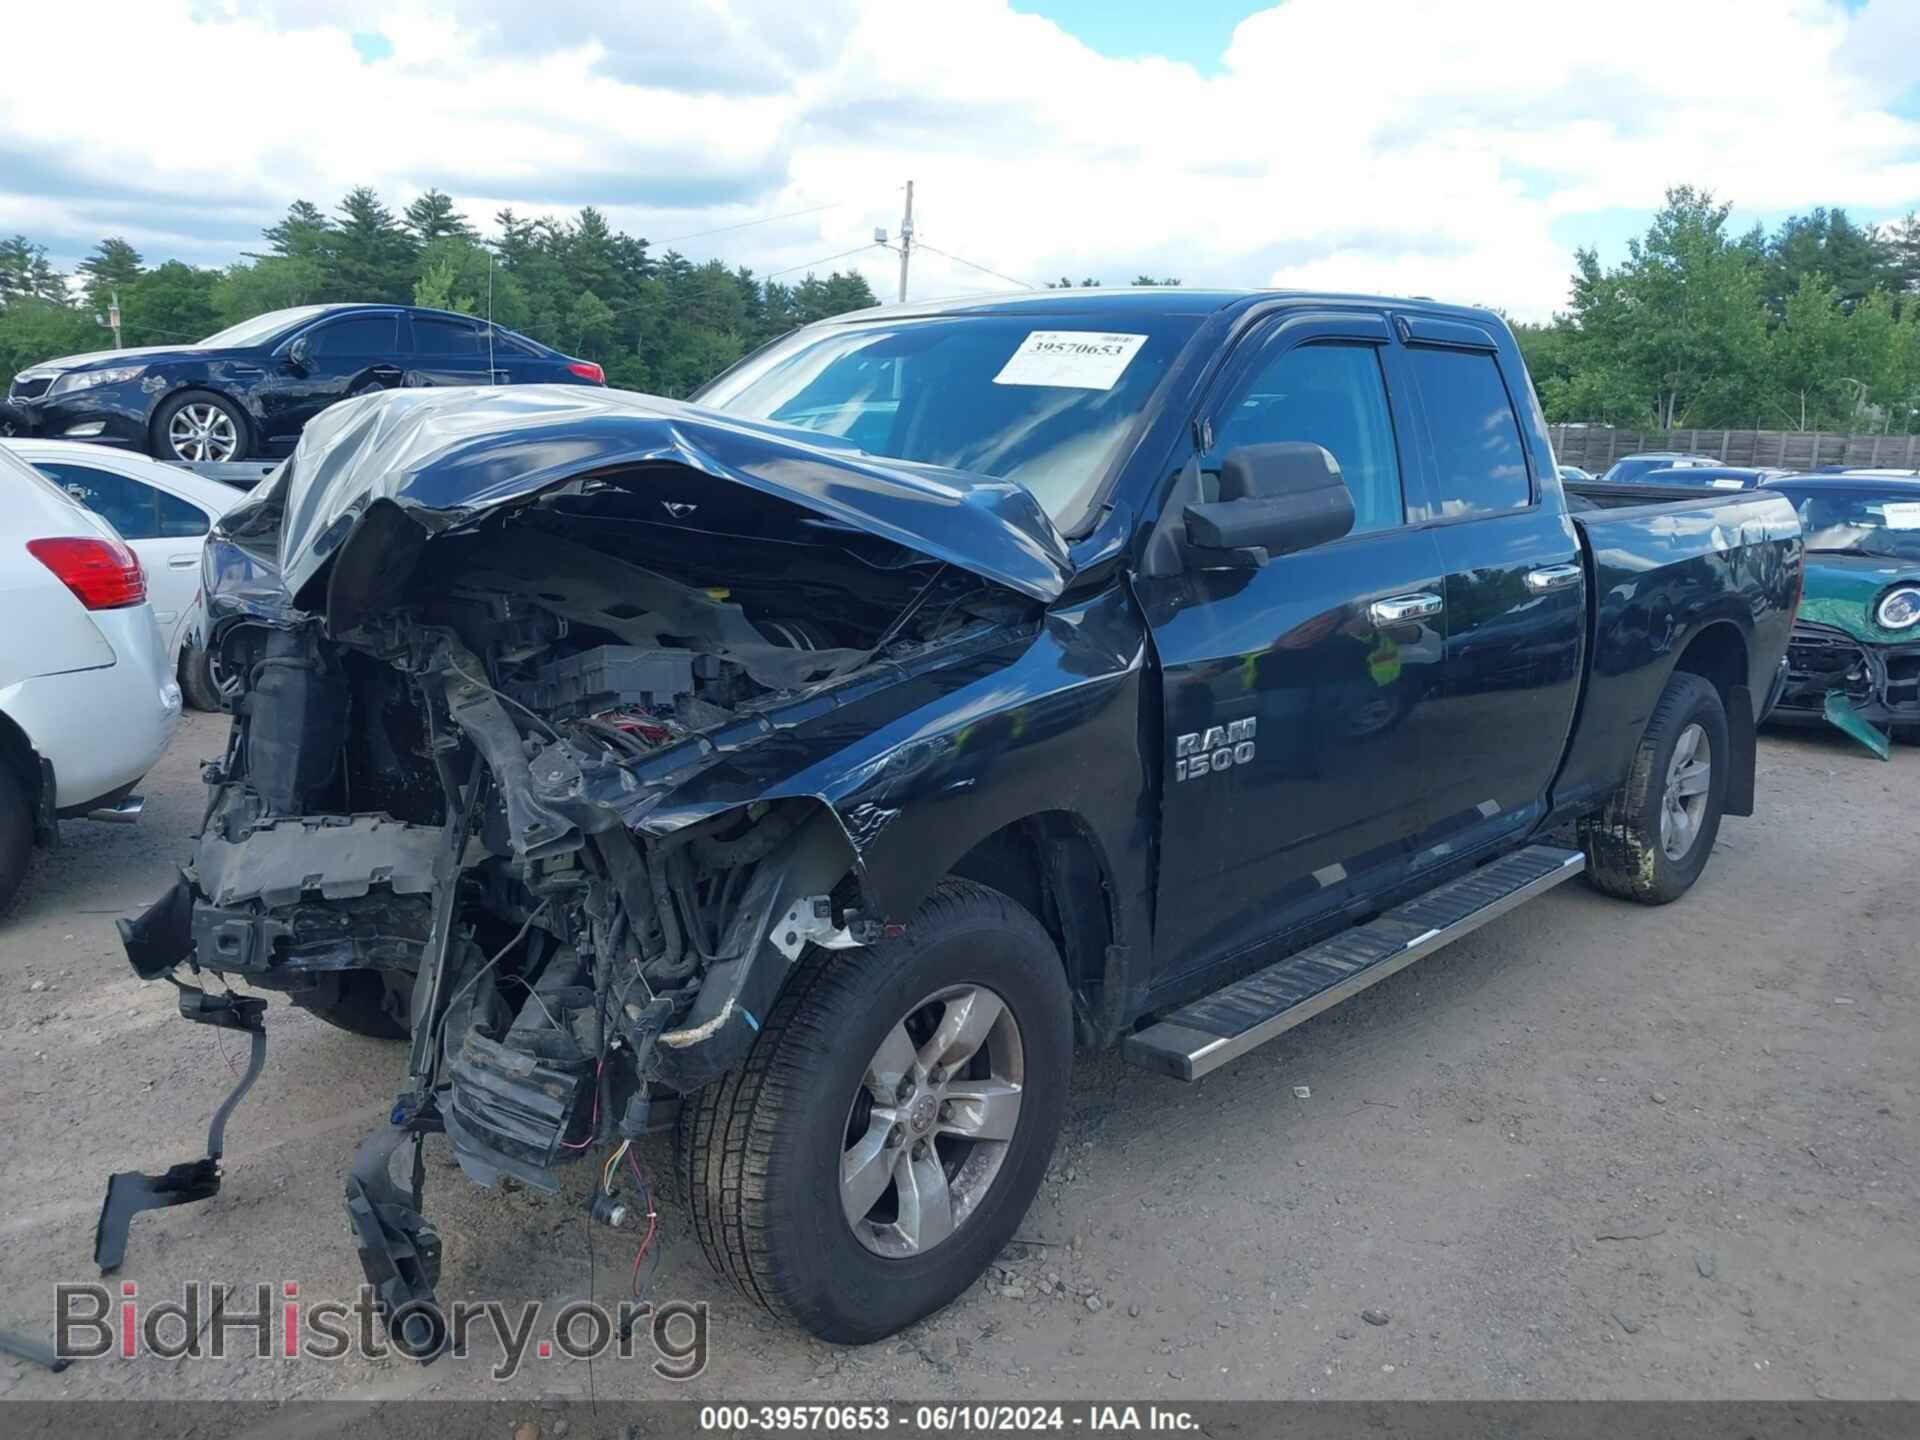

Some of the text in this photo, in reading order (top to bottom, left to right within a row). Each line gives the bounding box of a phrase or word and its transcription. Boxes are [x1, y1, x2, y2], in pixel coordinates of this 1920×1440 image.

[1029, 342, 1123, 356] 39570653
[1176, 716, 1256, 758] RAM
[1176, 741, 1255, 782] 1500
